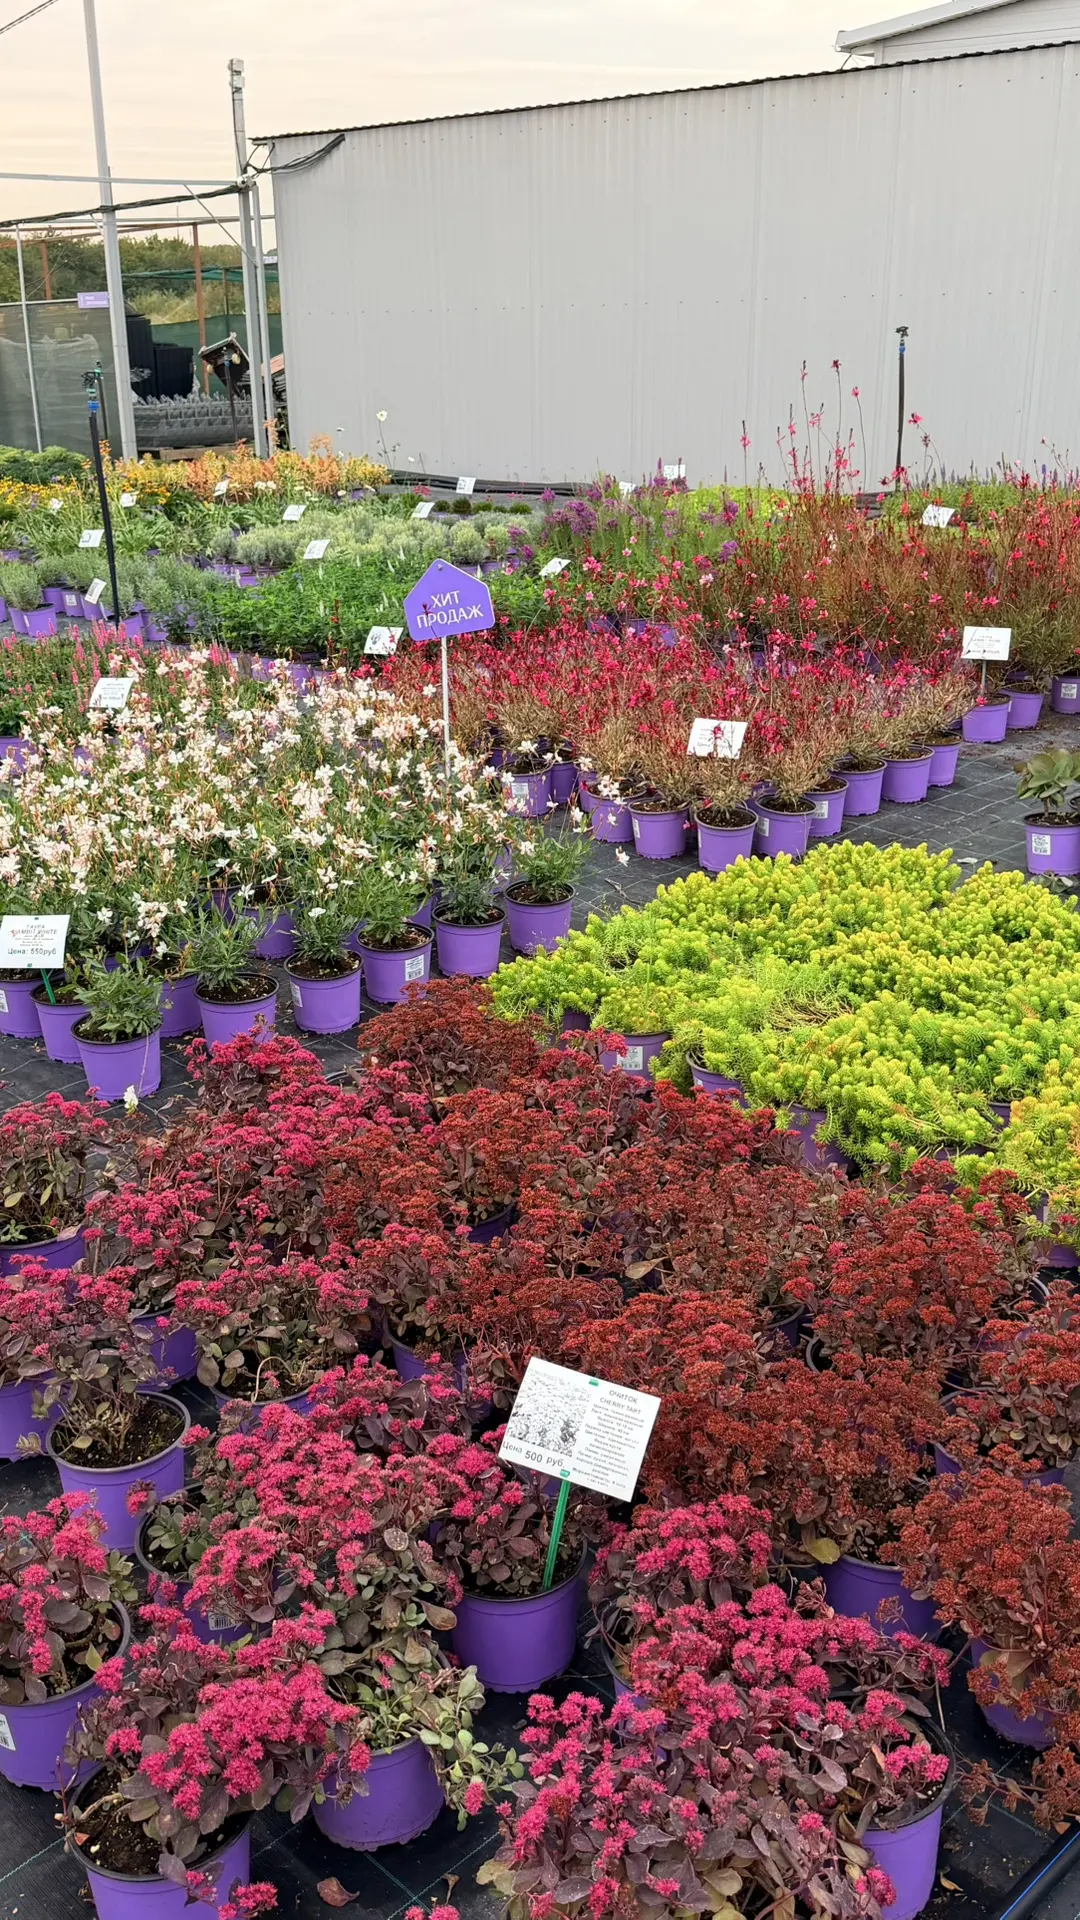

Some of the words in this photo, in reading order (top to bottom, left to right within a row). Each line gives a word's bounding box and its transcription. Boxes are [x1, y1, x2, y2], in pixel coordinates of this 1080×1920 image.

[430, 590, 460, 608] ХИТ
[416, 604, 484, 629] ПРОДАЖ
[599, 1397, 625, 1409] CHERRY
[625, 1405, 641, 1414] TART
[608, 1390, 638, 1403] ОЧИТОК
[502, 1440, 523, 1454] Цена
[524, 1450, 543, 1464] 500
[546, 1454, 565, 1469] руб.
